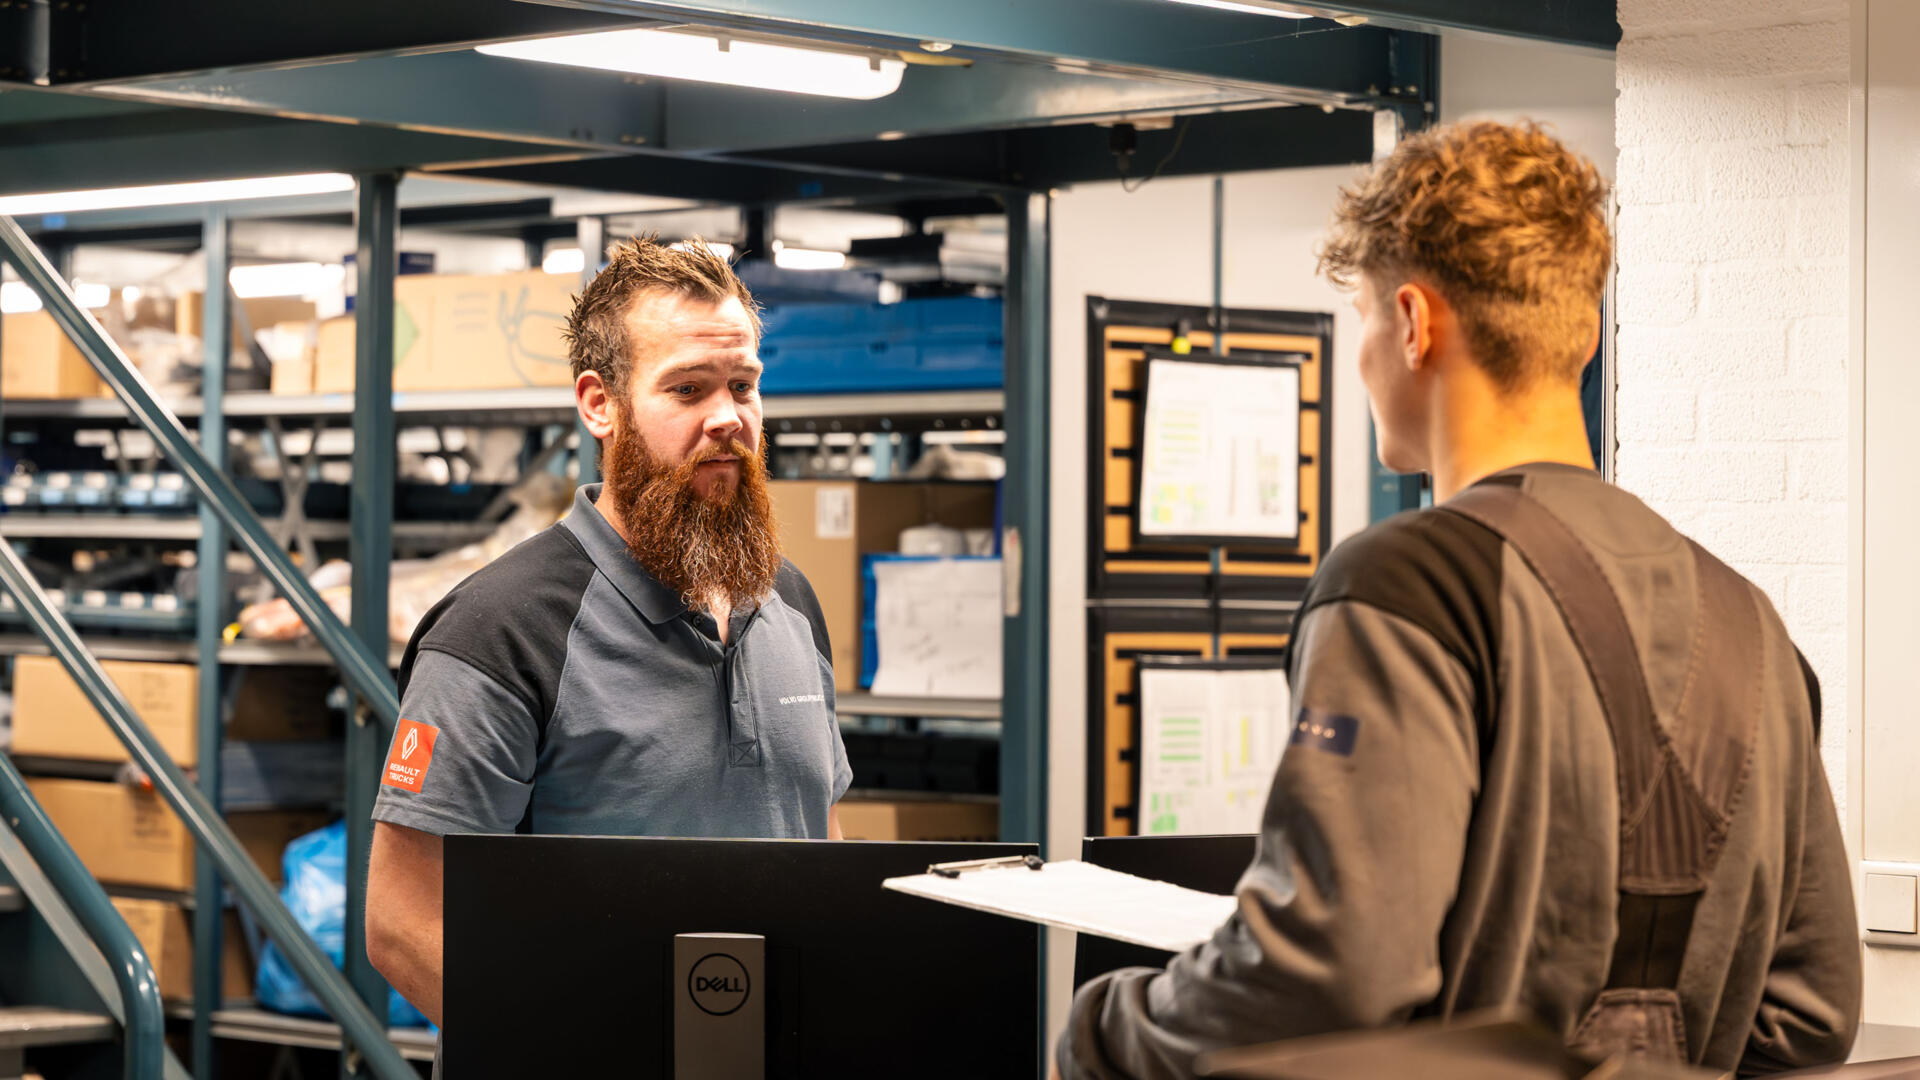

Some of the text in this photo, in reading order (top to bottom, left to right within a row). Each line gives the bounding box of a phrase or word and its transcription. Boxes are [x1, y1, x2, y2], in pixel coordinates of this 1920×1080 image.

[779, 696, 797, 705] VOLVO
[390, 762, 421, 777] RENAULT
[389, 772, 415, 784] TRUCKS
[696, 976, 744, 992] DELL
